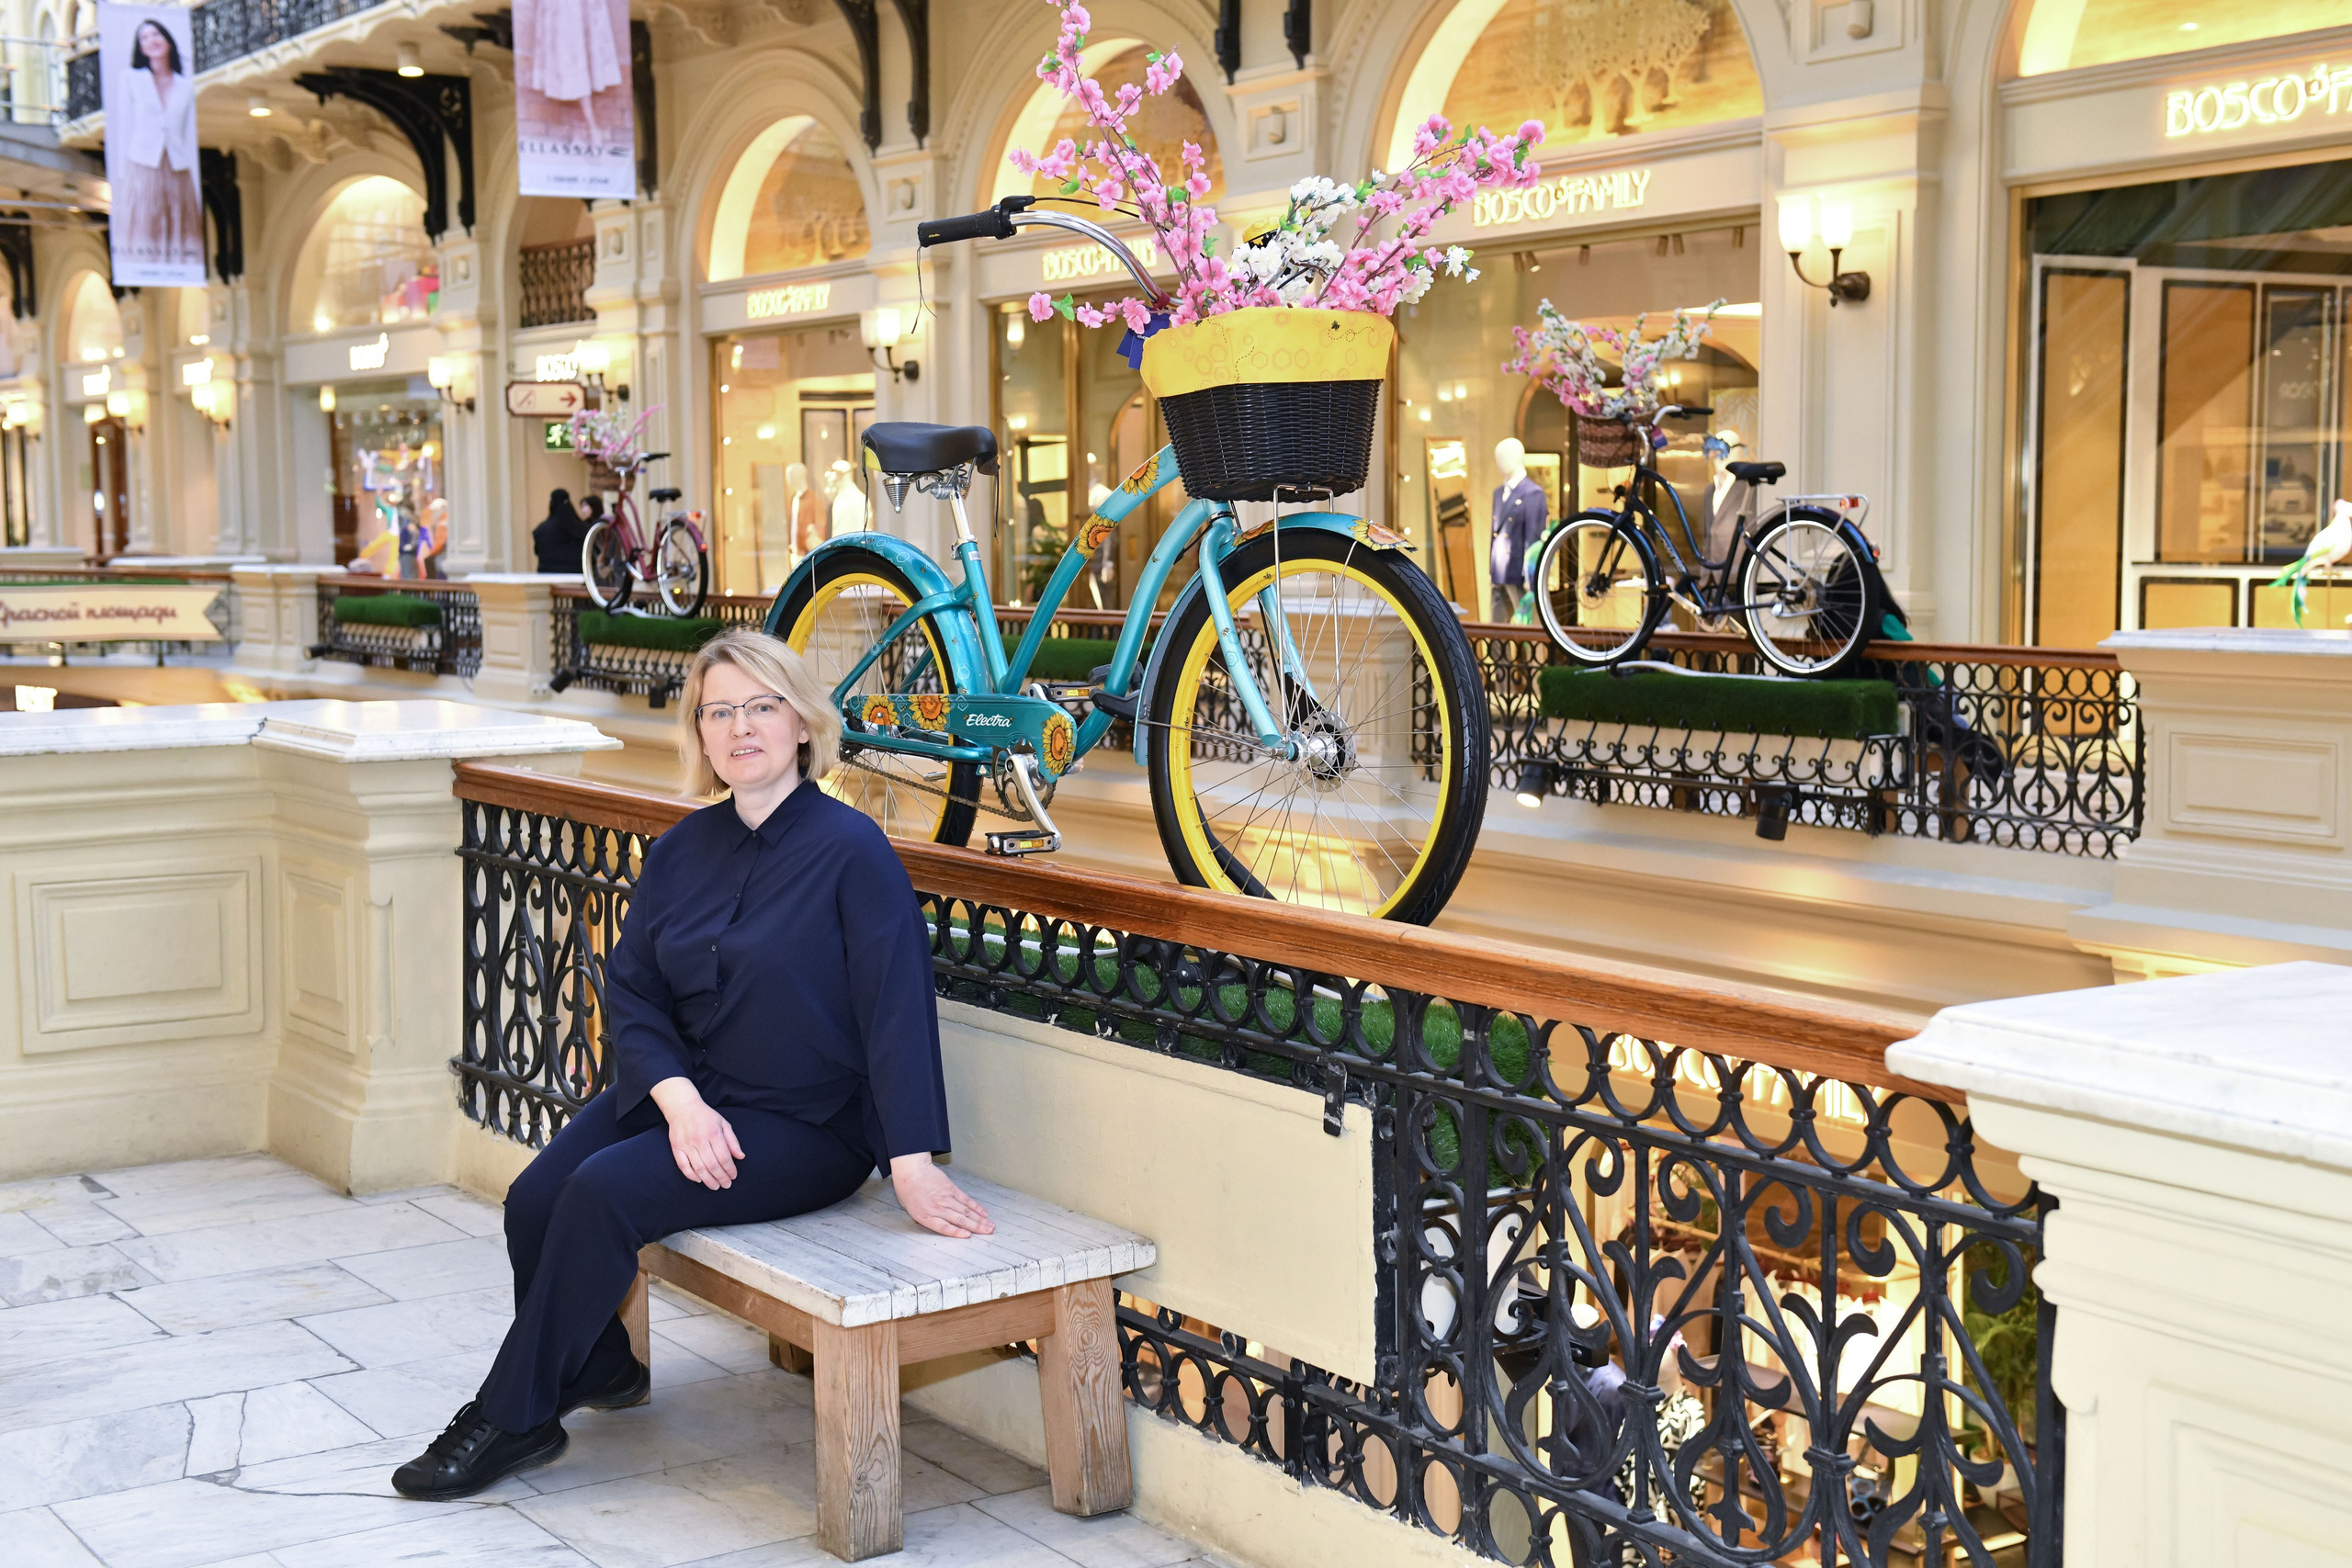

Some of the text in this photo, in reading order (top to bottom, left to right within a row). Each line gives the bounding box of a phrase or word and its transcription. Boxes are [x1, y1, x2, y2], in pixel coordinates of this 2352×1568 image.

[2165, 73, 2307, 138] BOSCO
[1473, 169, 1651, 227] BOSCO FAMILY
[1102, 238, 1158, 272] FAILY
[0, 600, 80, 628] расной
[966, 713, 1012, 728] Electra
